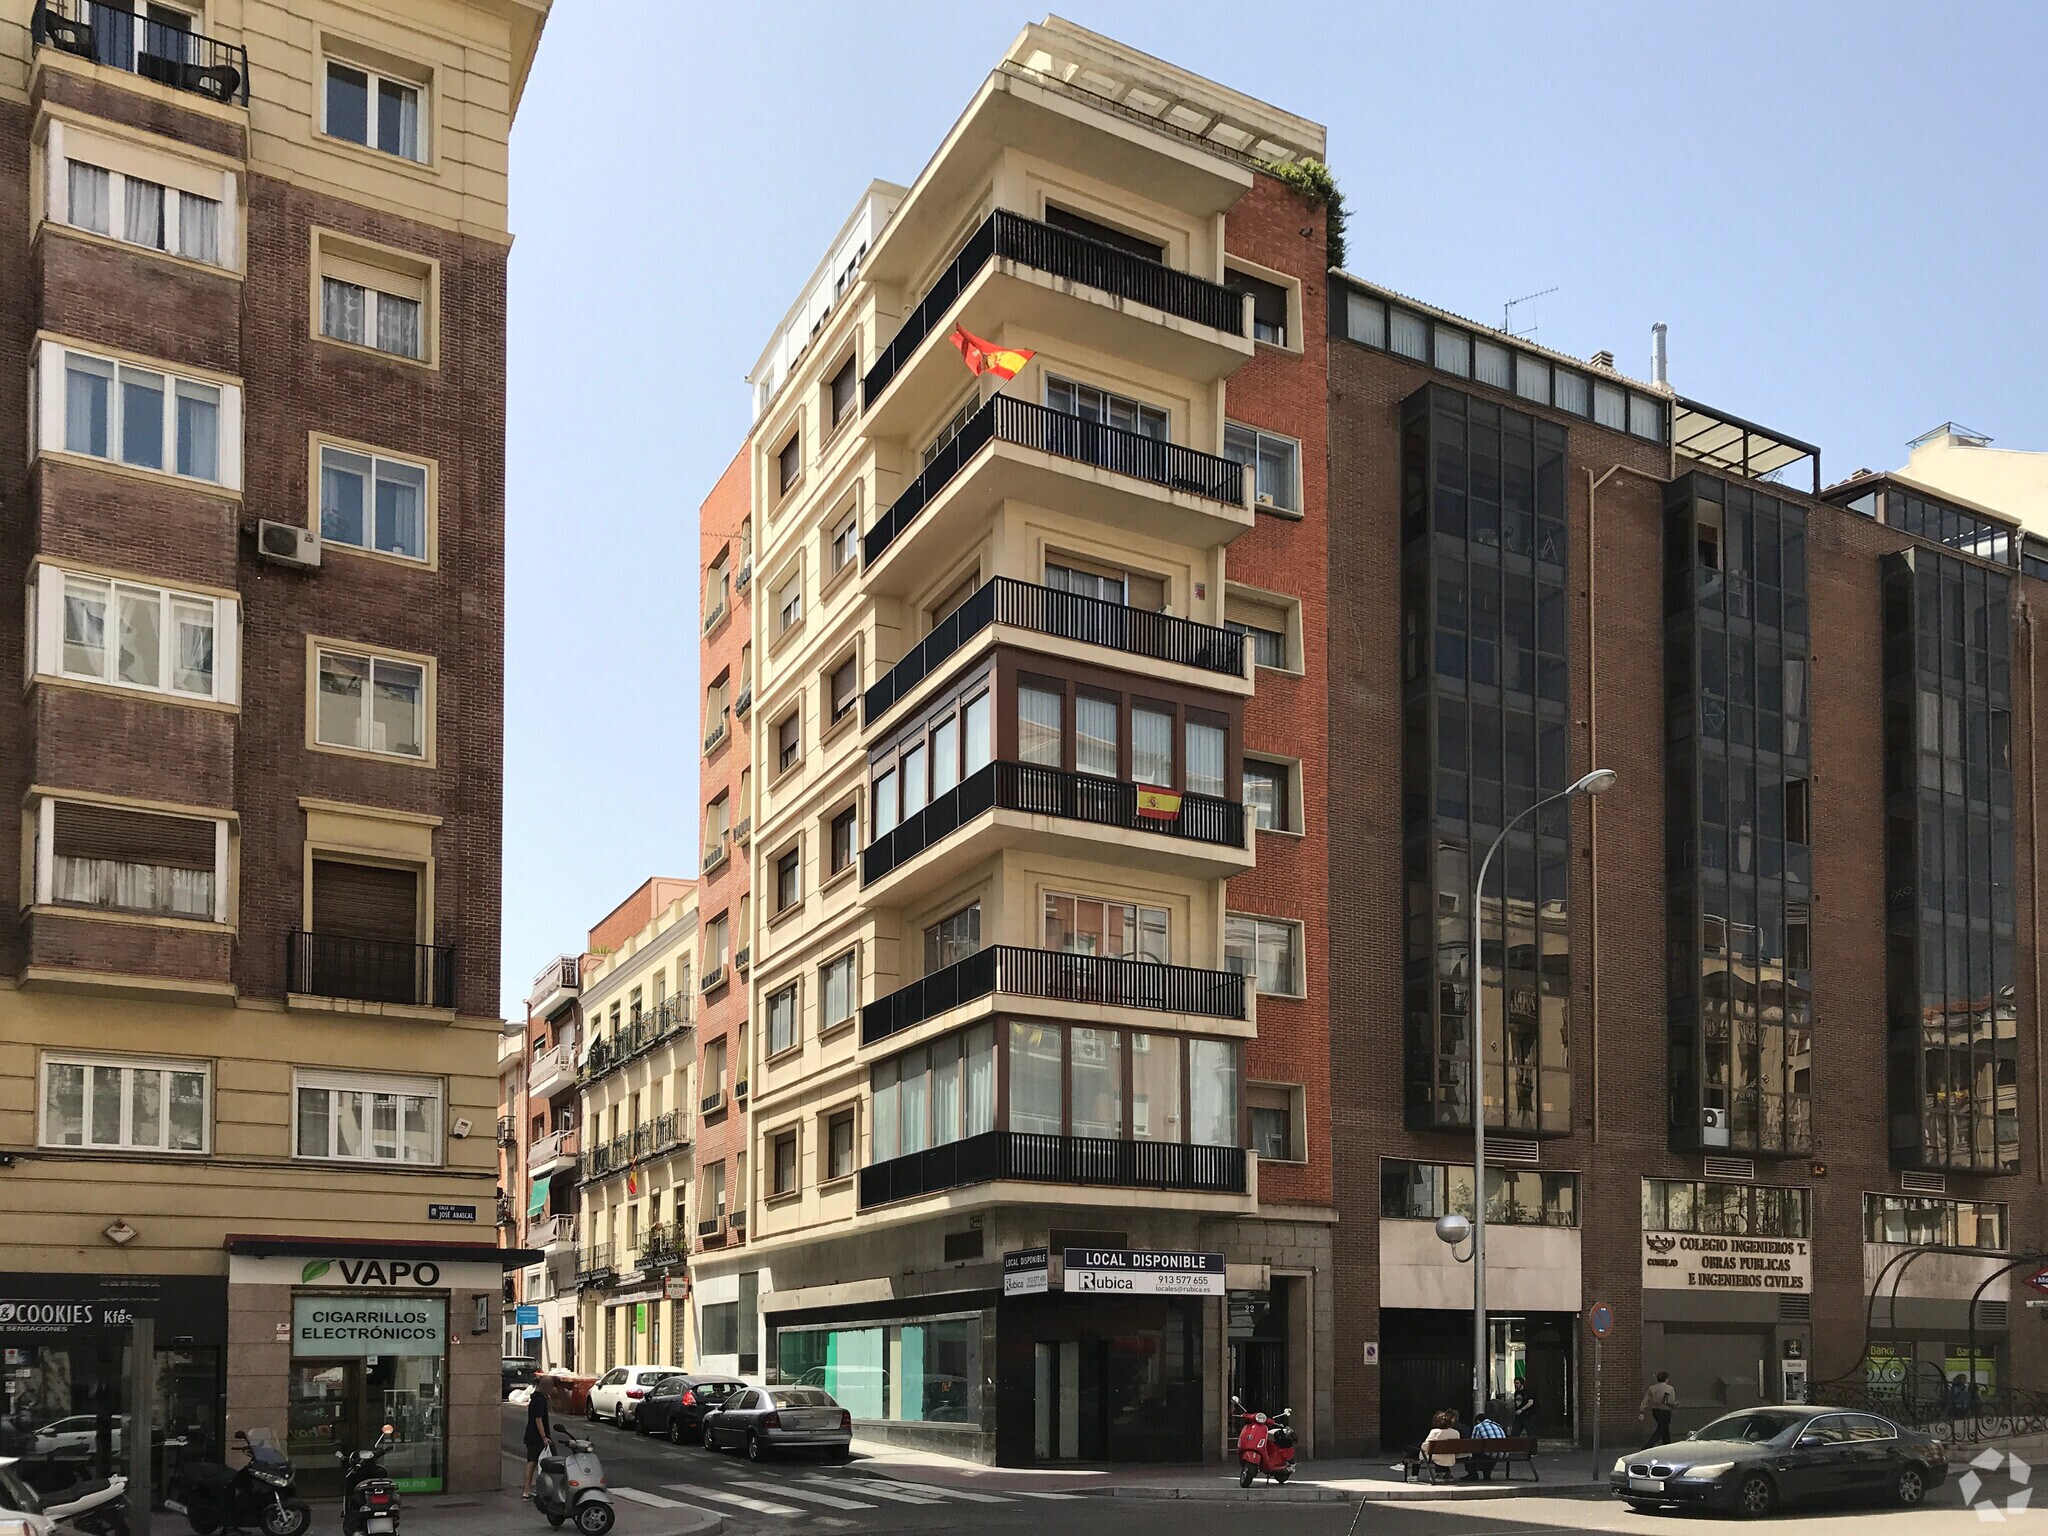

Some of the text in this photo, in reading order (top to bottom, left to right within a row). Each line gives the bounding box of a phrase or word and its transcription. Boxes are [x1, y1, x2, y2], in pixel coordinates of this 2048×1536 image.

[439, 1210, 451, 1219] JOSÉ
[1680, 1237, 1807, 1255] COLEGIO INGENIEROS T.
[1005, 1254, 1046, 1267] LOCAL DISPONIBLE
[1086, 1252, 1206, 1268] LOCAL DISPONIBLE
[1647, 1258, 1678, 1267] CONSEJO
[1701, 1256, 1791, 1271] OBRAS PUBLICAS
[338, 1260, 440, 1286] VAPO
[1004, 1278, 1024, 1291] Rubica
[1079, 1272, 1134, 1291] Rubica
[1158, 1275, 1208, 1285] 913 577 655
[1688, 1272, 1804, 1289] E INGENIEROS CIVILES
[1155, 1285, 1211, 1293] locales@rubica.es
[16, 1304, 93, 1323] COOKIES
[1244, 1304, 1255, 1313] 22
[312, 1311, 428, 1323] CIGARRILLOS
[301, 1325, 437, 1340] ELECTRÓNICOS
[1956, 1347, 1982, 1357] Bania
